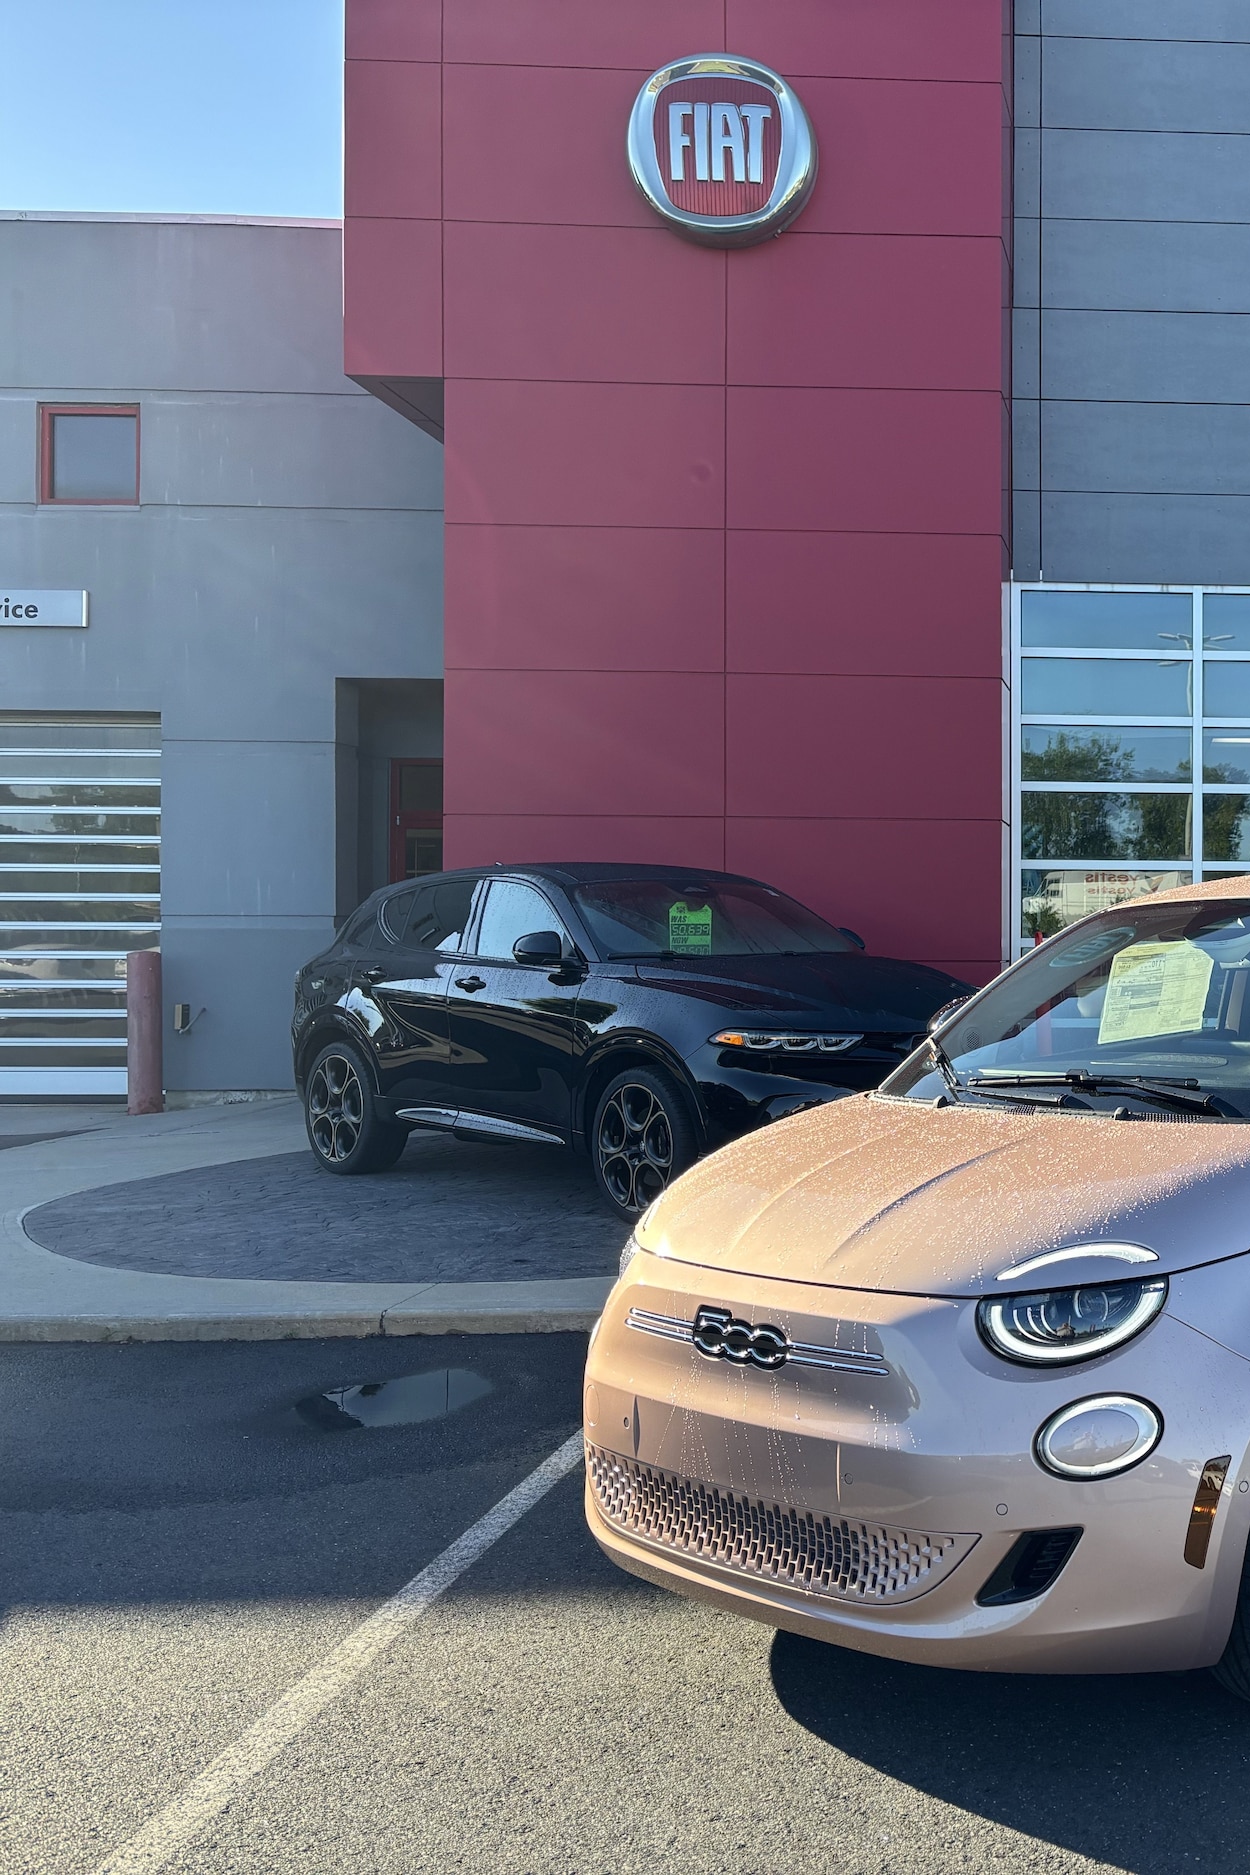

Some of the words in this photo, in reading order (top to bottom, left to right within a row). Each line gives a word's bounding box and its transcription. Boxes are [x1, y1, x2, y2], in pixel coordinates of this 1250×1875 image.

[668, 102, 772, 184] FIAT
[0, 597, 39, 619] ice
[671, 915, 688, 923] WAS
[694, 1304, 790, 1371] 500
